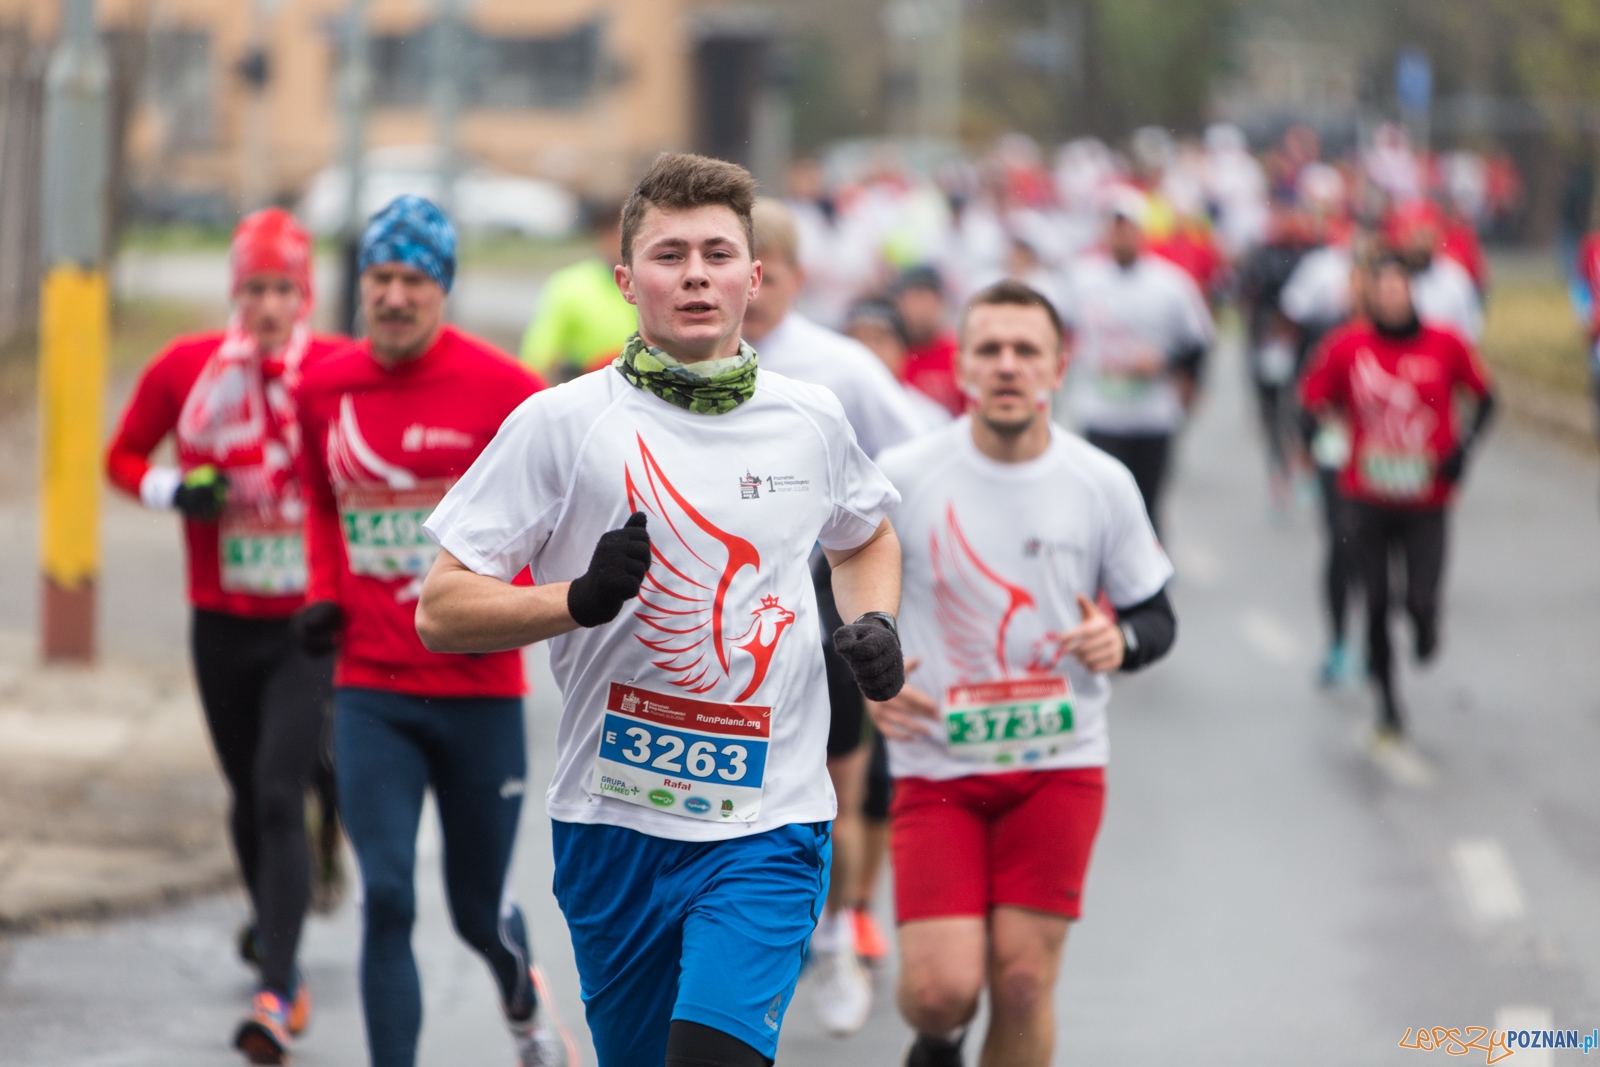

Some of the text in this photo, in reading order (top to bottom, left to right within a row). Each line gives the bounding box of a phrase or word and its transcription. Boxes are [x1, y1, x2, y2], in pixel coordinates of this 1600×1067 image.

[766, 475, 776, 492] 1
[696, 713, 761, 730] RunPoland.org
[963, 702, 1063, 742] 3736
[605, 726, 749, 782] E 3263
[600, 782, 630, 796] LUXMED
[601, 775, 626, 788] GRUPA
[663, 778, 692, 791] Rafał
